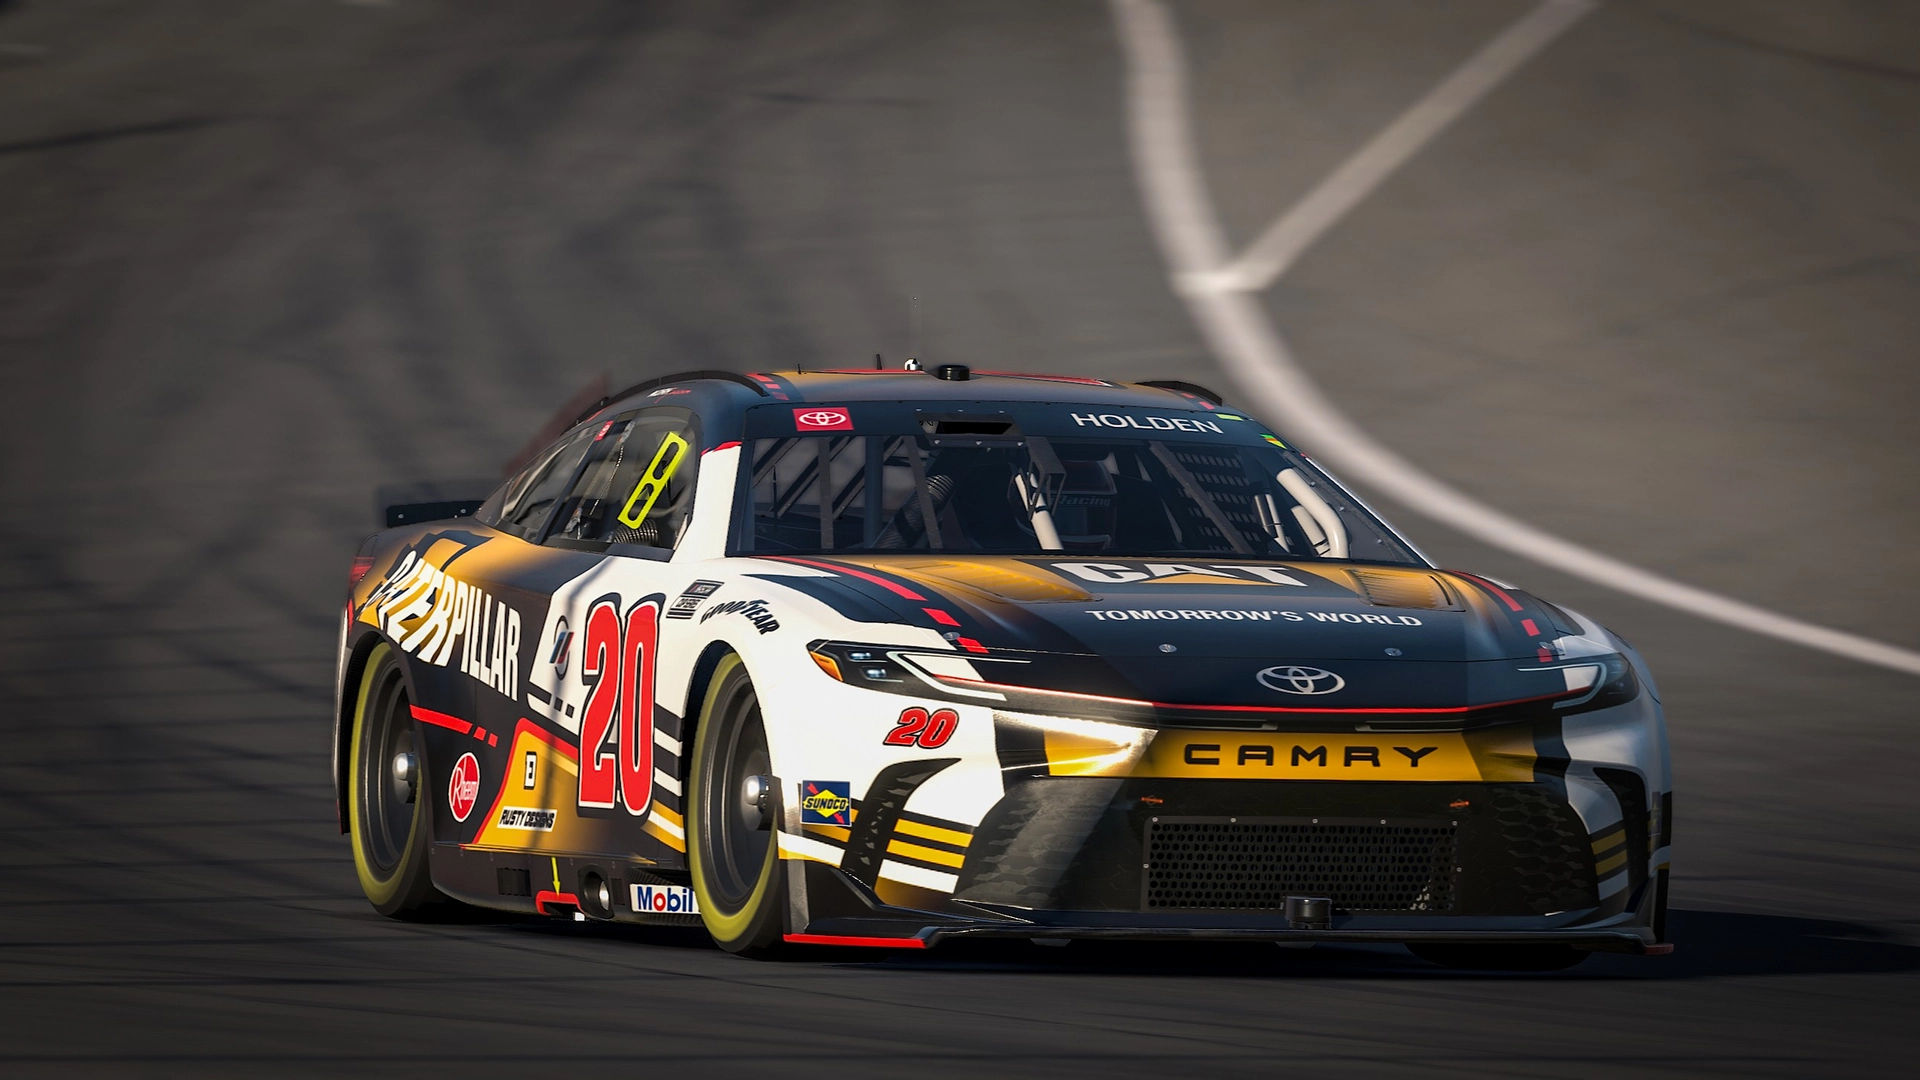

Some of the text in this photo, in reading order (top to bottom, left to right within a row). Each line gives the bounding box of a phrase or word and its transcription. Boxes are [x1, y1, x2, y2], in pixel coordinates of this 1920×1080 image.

[1071, 413, 1224, 434] HOLDEN
[1051, 563, 1307, 587] CAT
[357, 550, 521, 702] CATERPILLAR
[1085, 609, 1423, 626] TOMORROW'S WORLD
[577, 592, 666, 820] 20
[883, 706, 959, 749] 20
[1184, 744, 1438, 768] CAMRY
[804, 797, 847, 811] SUNOCO
[499, 809, 526, 826] RUSTY
[637, 886, 693, 912] Mobil
